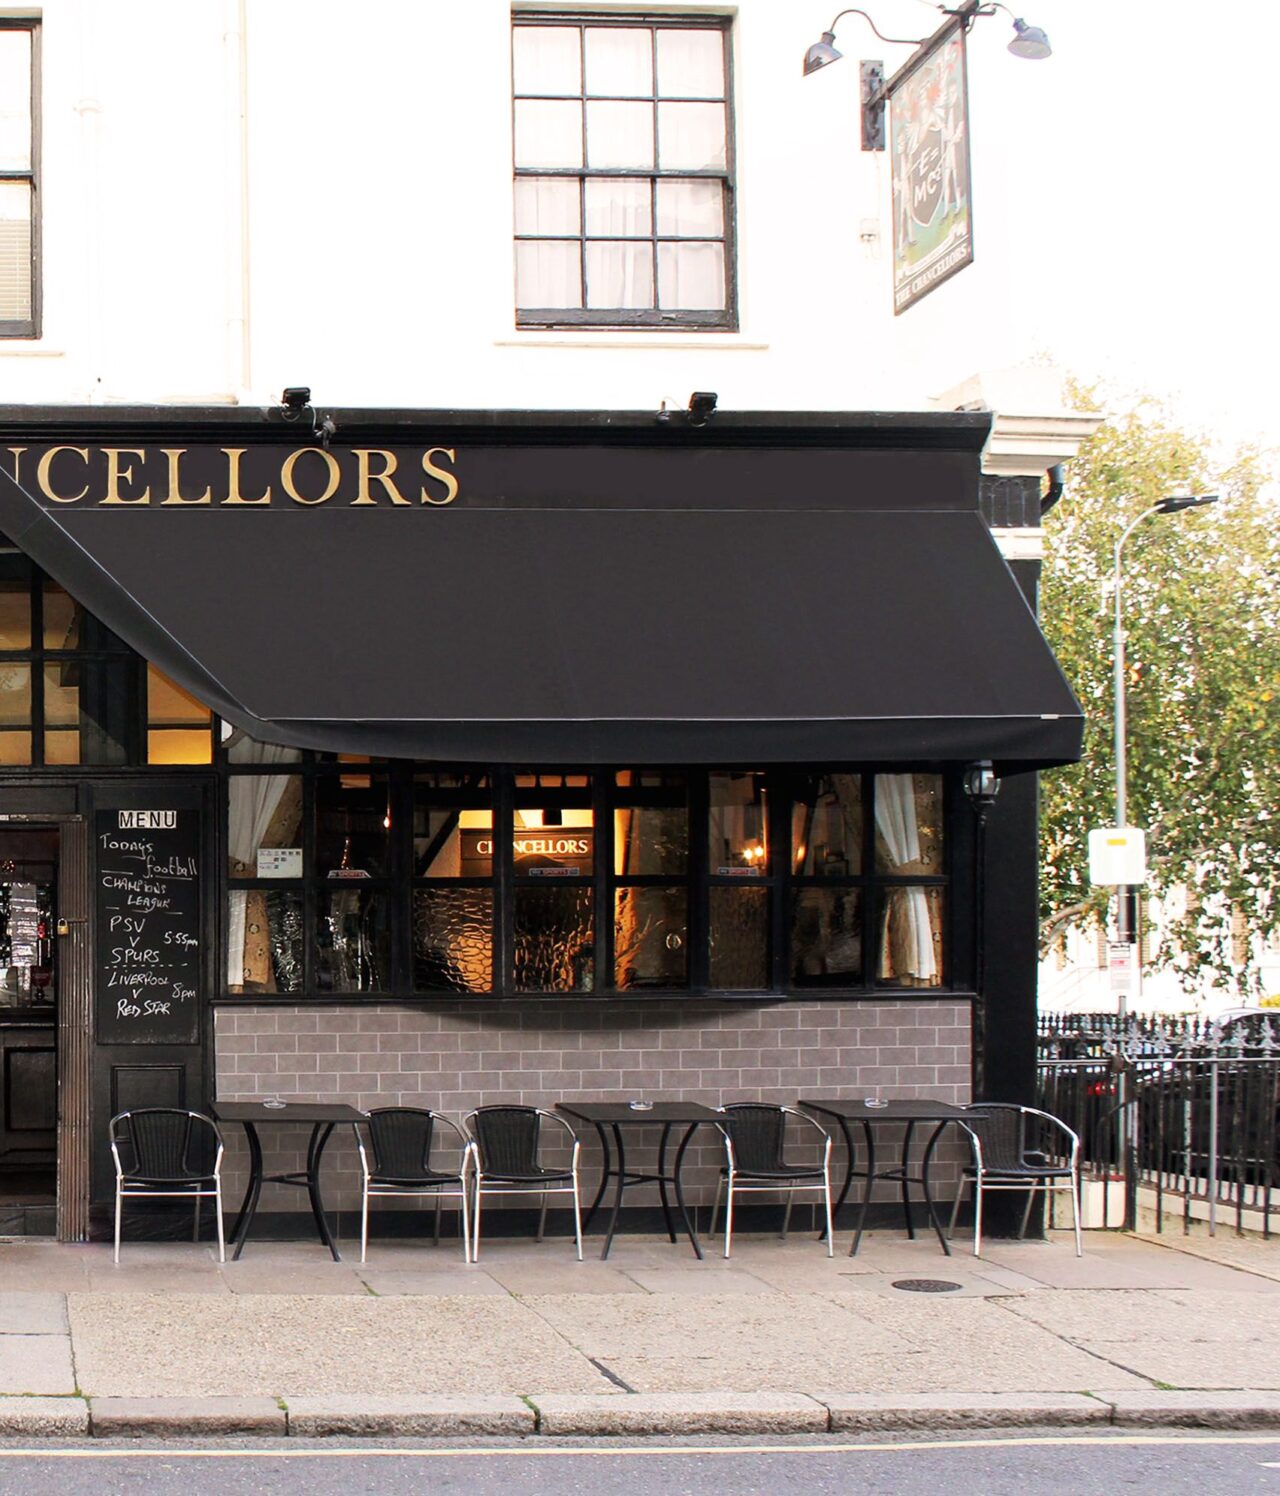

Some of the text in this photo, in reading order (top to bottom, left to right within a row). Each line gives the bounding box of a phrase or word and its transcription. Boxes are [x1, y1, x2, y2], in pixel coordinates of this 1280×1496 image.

[120, 811, 175, 828] MENU
[476, 839, 589, 854] CNCELLORS
[110, 915, 146, 933] PSV
[111, 948, 160, 963] SPURS
[143, 1000, 171, 1016] STAR
